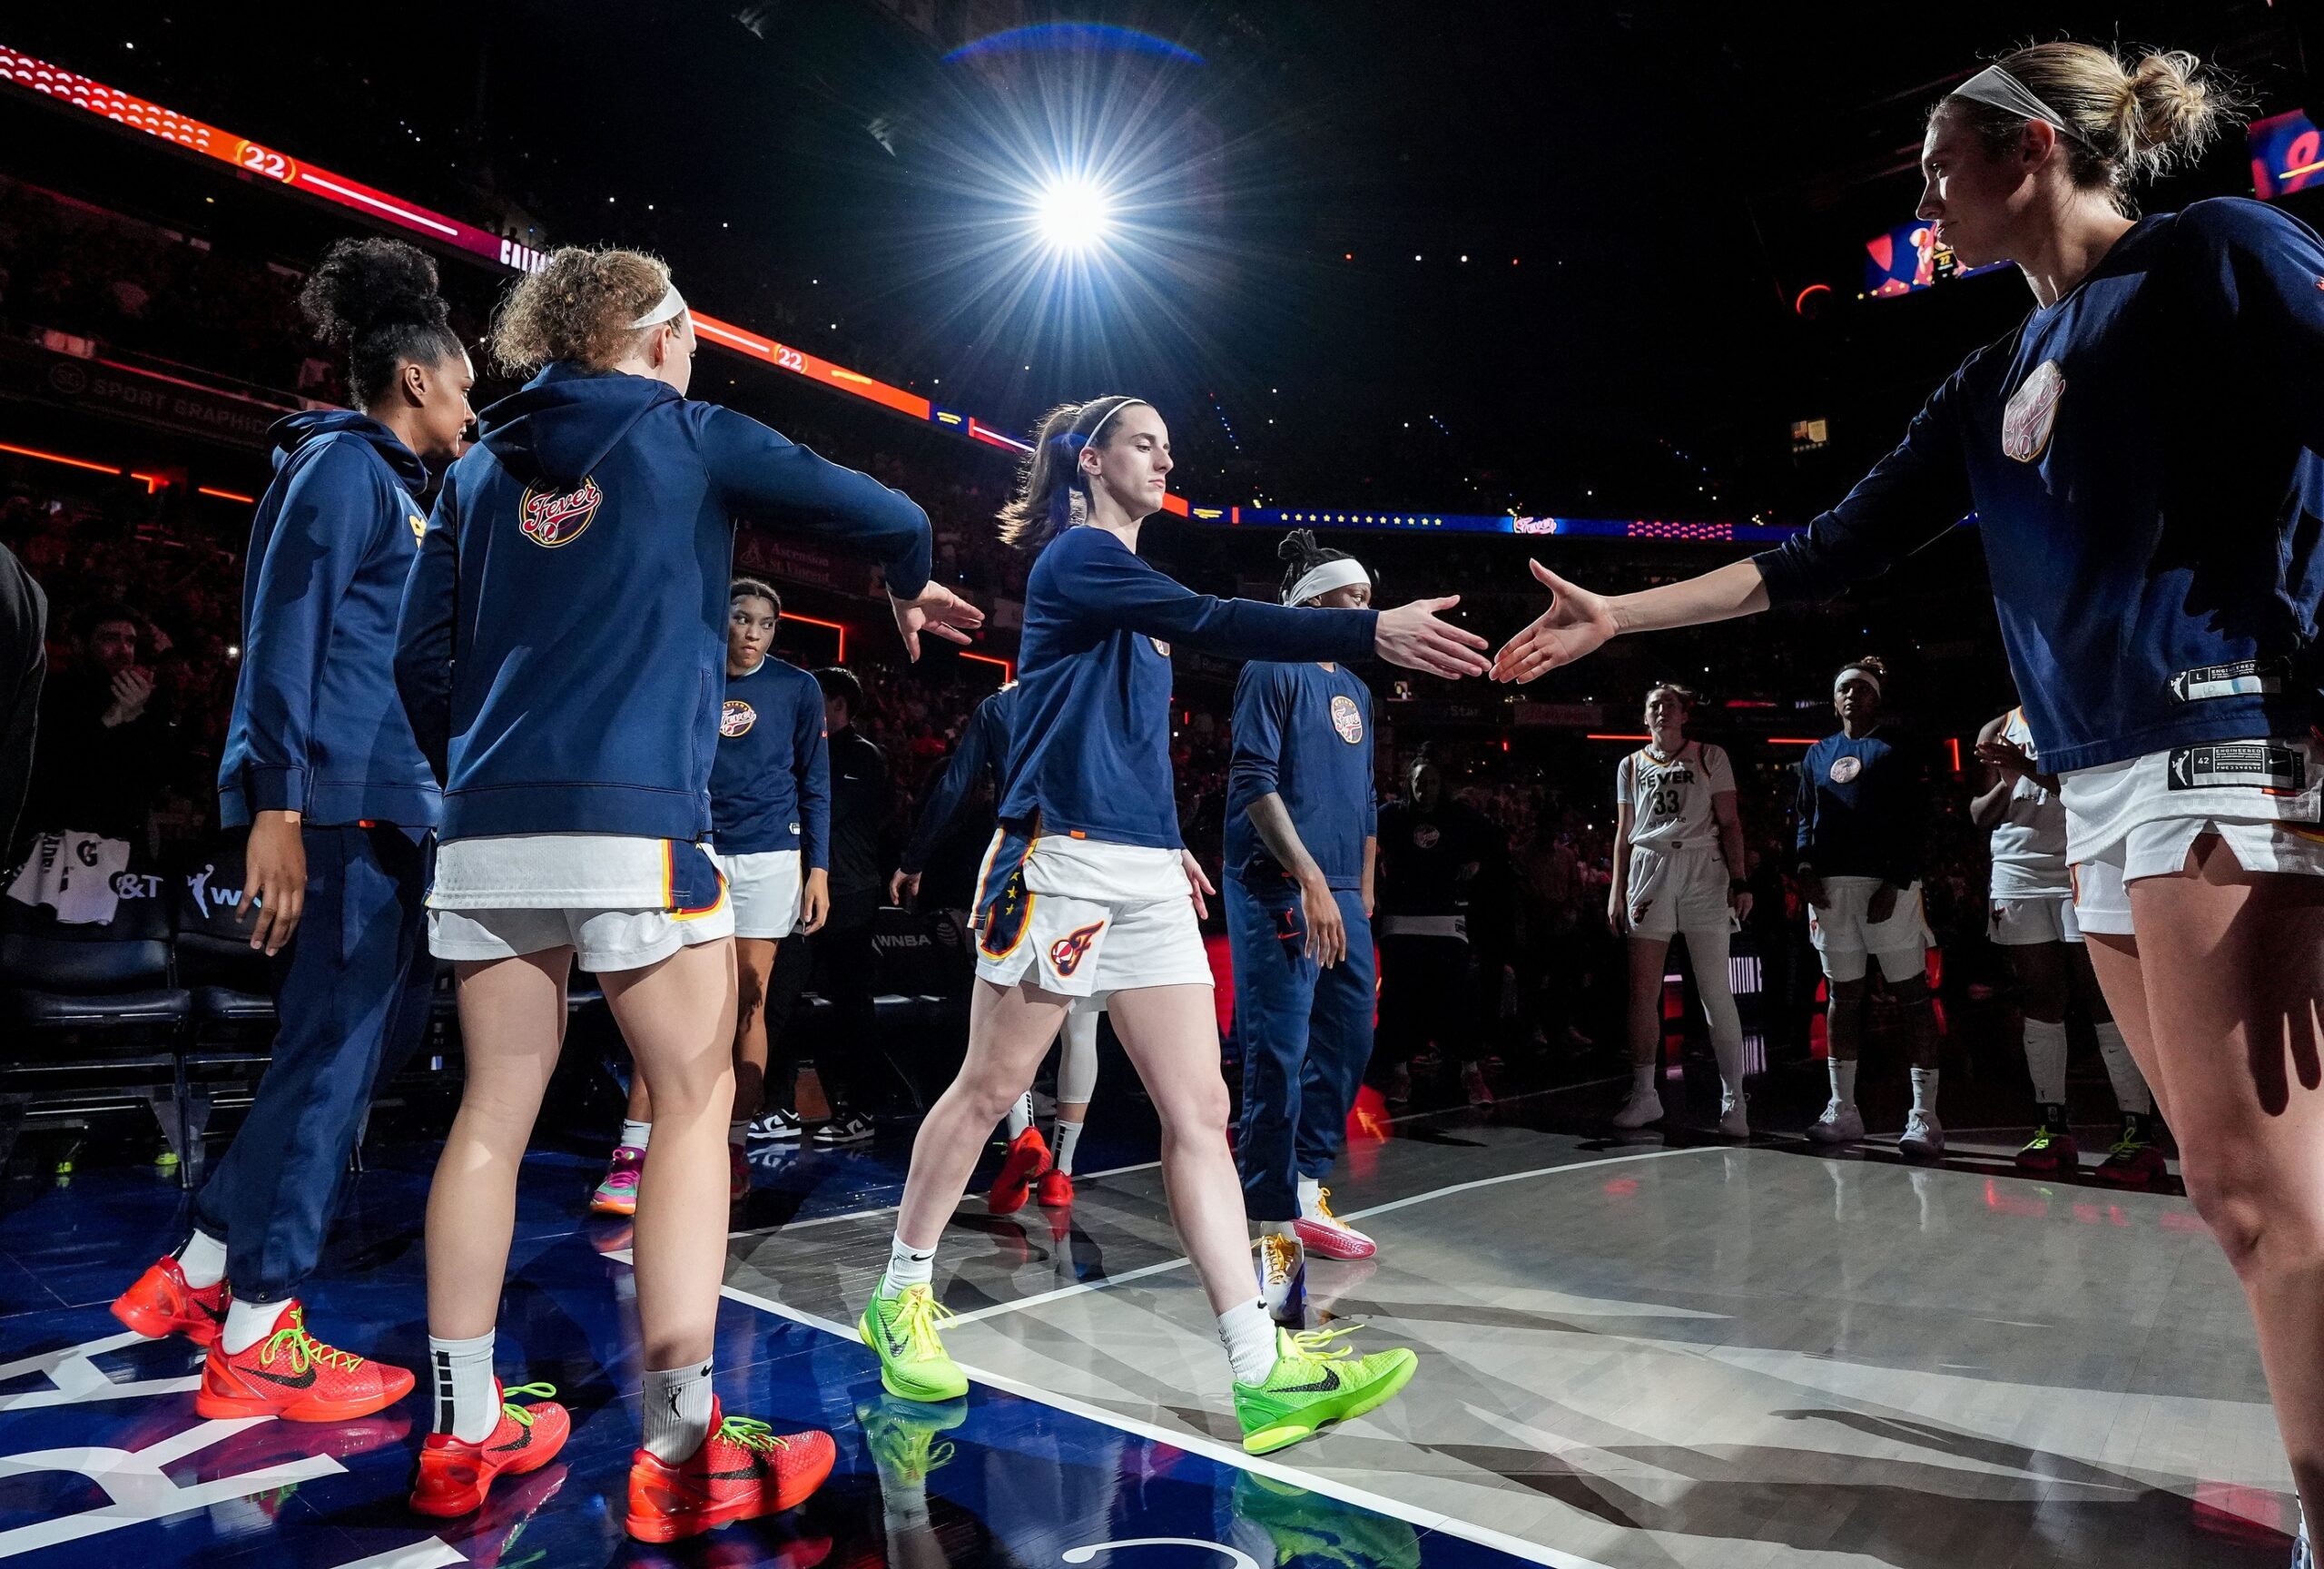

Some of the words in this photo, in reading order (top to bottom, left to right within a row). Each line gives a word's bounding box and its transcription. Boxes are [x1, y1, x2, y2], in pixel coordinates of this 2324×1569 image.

[243, 145, 286, 180] 22
[500, 239, 553, 275] CAIT
[778, 348, 803, 372] 22
[94, 378, 167, 410] SPORT
[2004, 373, 2066, 457] Fever
[523, 484, 602, 533] Fever
[2197, 756, 2210, 765] 42
[1640, 769, 1695, 792] FEVER
[1653, 790, 1679, 815] 33
[875, 933, 932, 947] WNBA
